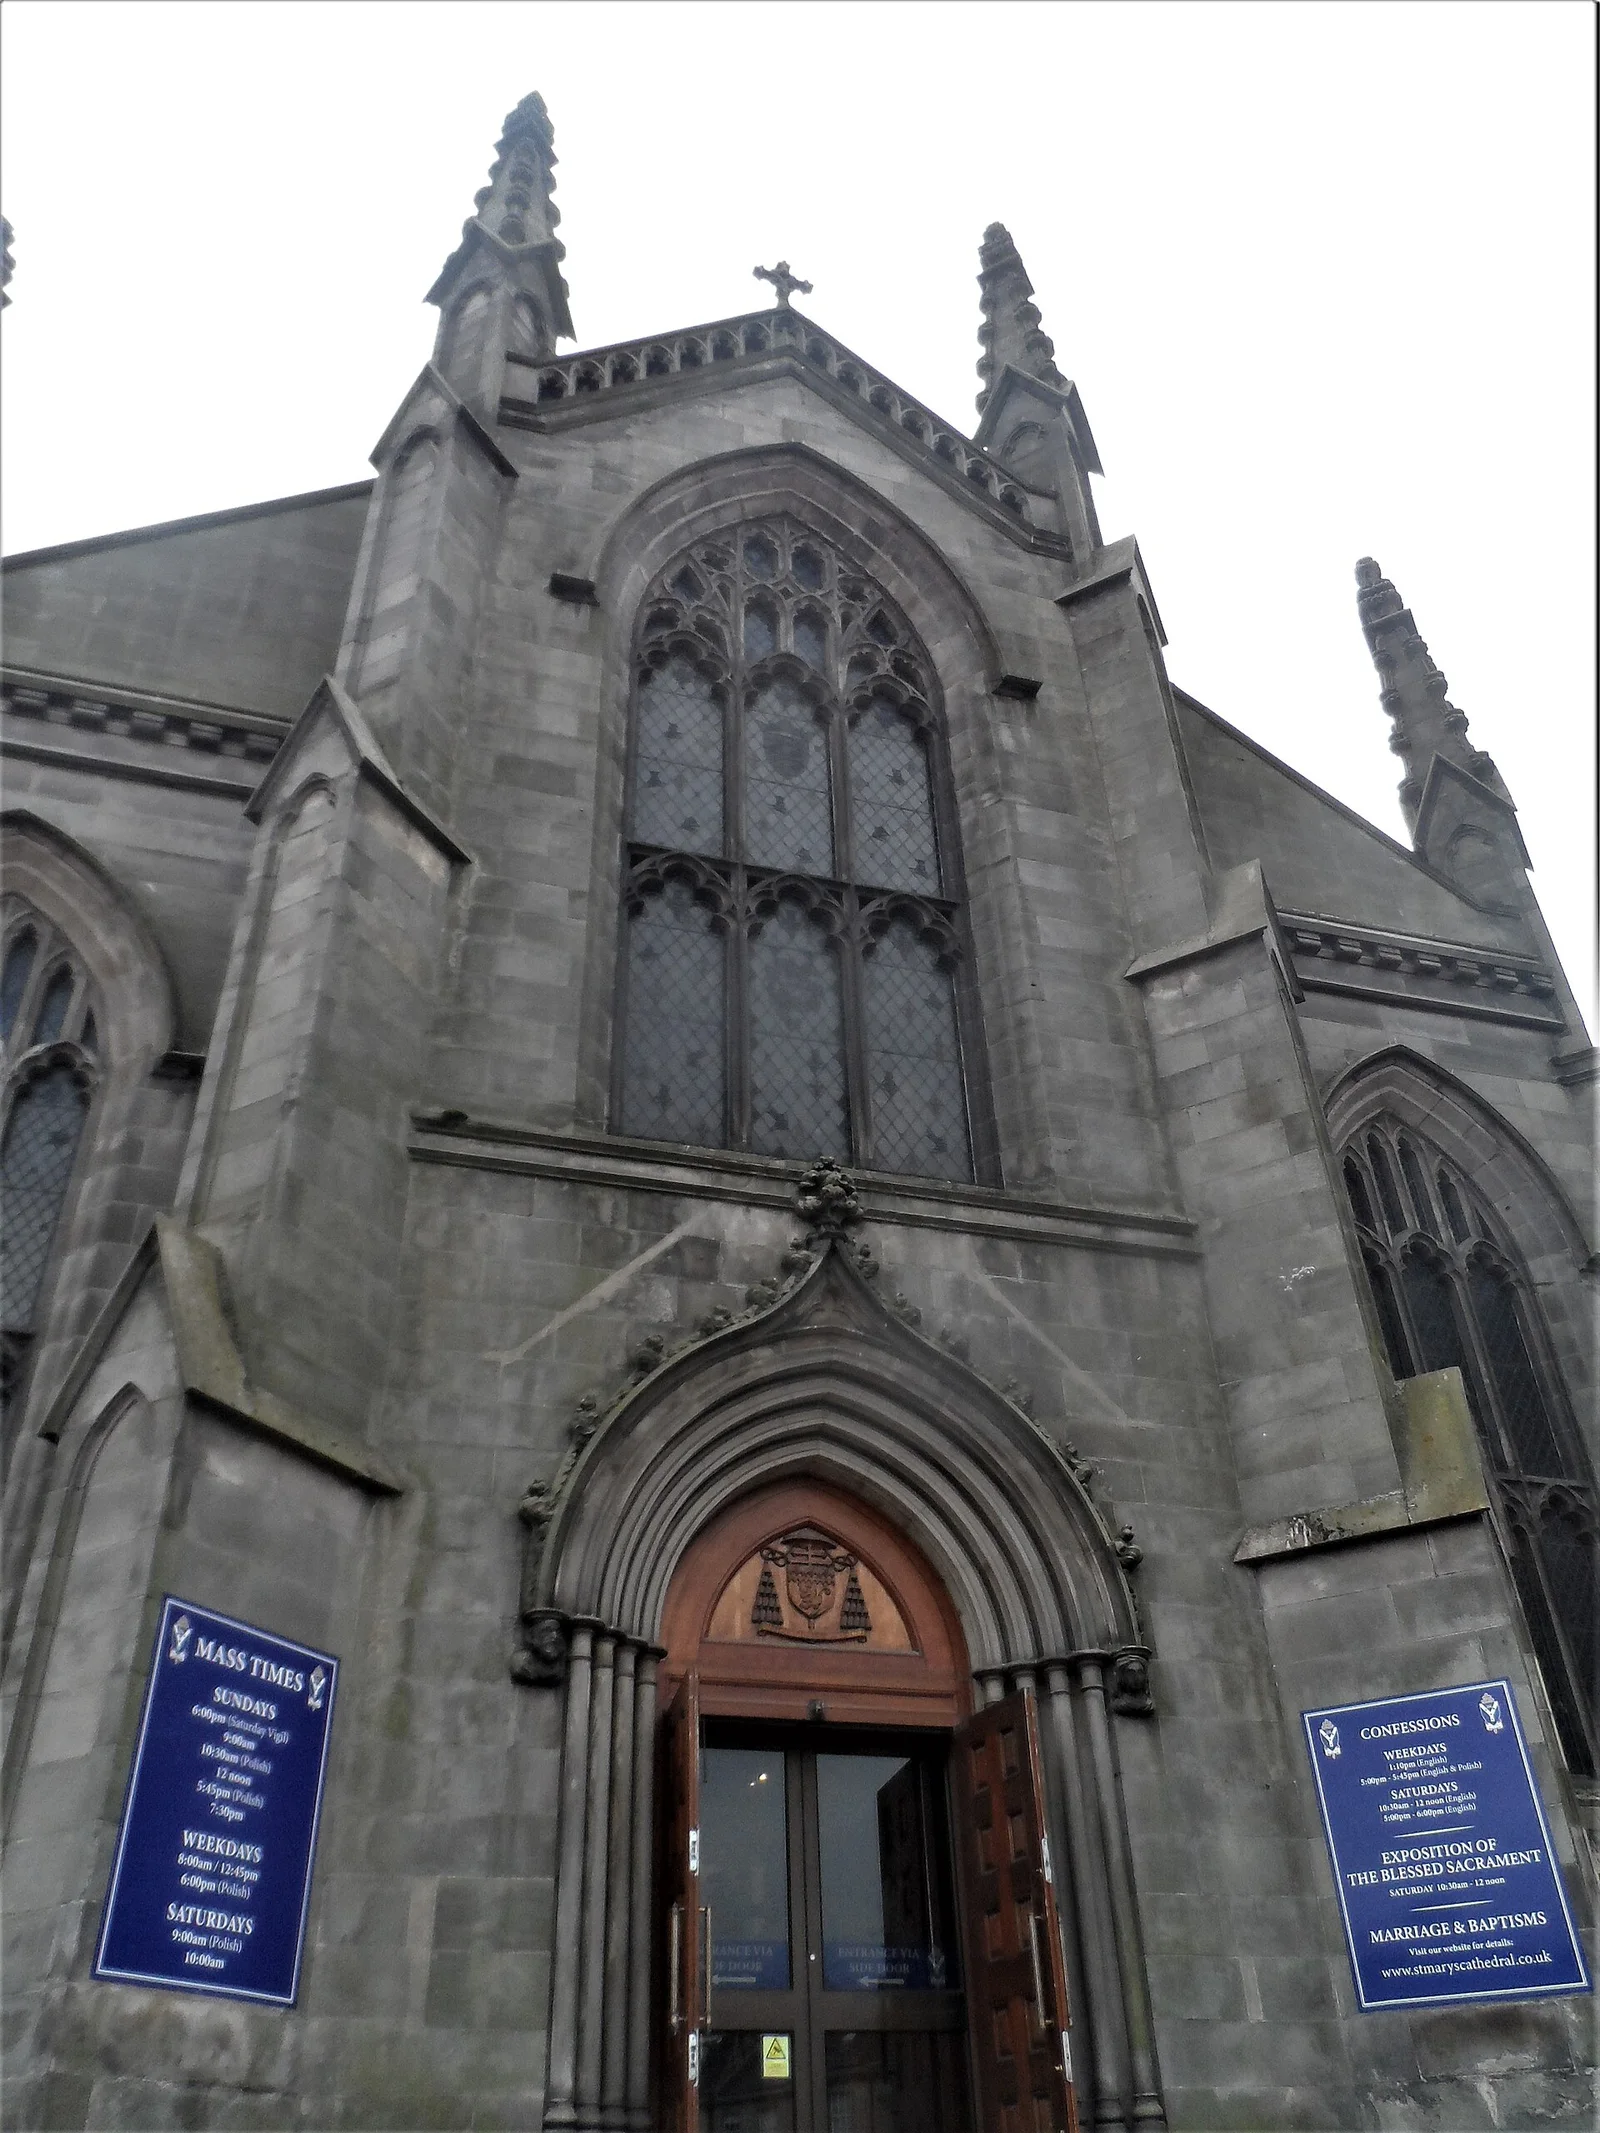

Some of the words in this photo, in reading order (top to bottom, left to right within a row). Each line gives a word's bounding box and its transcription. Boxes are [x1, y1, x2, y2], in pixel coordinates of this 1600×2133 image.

[194, 1637, 247, 1672] MASS
[250, 1653, 305, 1692] TIMES
[213, 1686, 277, 1720] SUNDAYS
[191, 1705, 226, 1724] 6:00pm
[228, 1714, 267, 1739] (Saturday
[267, 1727, 290, 1744] Vigil)
[1360, 1713, 1460, 1740] CONFESSIONS
[223, 1731, 255, 1750] 9:00am
[1383, 1742, 1447, 1761] WEEKDAYS
[200, 1743, 239, 1764] 10:30am
[240, 1755, 271, 1775] (Polish)
[1389, 1761, 1416, 1771] 1:10pm
[1416, 1755, 1448, 1768] (English)
[216, 1767, 227, 1780] 12
[228, 1770, 252, 1786] noon
[1360, 1775, 1387, 1786] 5:00pm
[1392, 1770, 1420, 1781] 5:45pm
[1420, 1766, 1449, 1778] (English
[1450, 1765, 1457, 1773] &
[1458, 1761, 1482, 1772] Polish)
[196, 1780, 231, 1799] 5:45pm
[232, 1789, 264, 1809] (Polish)
[1378, 1802, 1409, 1813] 10:30am
[1415, 1799, 1424, 1807] 12
[1425, 1797, 1445, 1806] noon
[1445, 1791, 1477, 1804] (English)
[1390, 1781, 1458, 1800] SATURDAYS
[210, 1802, 244, 1822] 7:30pm
[1383, 1811, 1411, 1822] 5:00pm
[1416, 1807, 1444, 1818] 6:00pm
[1445, 1802, 1477, 1815] (English)
[182, 1829, 262, 1863] WEEKDAYS
[1381, 1841, 1473, 1865] EXPOSITION
[1475, 1838, 1497, 1851] OF
[177, 1852, 213, 1871] 8:00am
[220, 1862, 258, 1882] 12:45pm
[1347, 1870, 1379, 1886] THE
[1380, 1862, 1444, 1882] BLESSED
[1446, 1849, 1541, 1874] SACRAMENT
[180, 1873, 216, 1893] 6:00pm
[217, 1880, 251, 1900] (Polish)
[1389, 1884, 1434, 1897] SATURDAY
[1437, 1880, 1468, 1892] 10:30am
[1475, 1878, 1484, 1887] 12
[1485, 1876, 1505, 1886] noon
[166, 1902, 254, 1935] SATURDAYS
[1369, 1922, 1451, 1944] MARRIAGE
[1454, 1920, 1466, 1934] &
[1467, 1911, 1547, 1933] BAPTISMS
[172, 1928, 207, 1947] 9:00am
[208, 1934, 243, 1953] (Polish)
[838, 1947, 898, 1959] ENTRANCE
[900, 1947, 920, 1960] VIA
[1408, 1947, 1427, 1957] Visit
[1428, 1947, 1441, 1955] our
[1443, 1942, 1471, 1953] website
[1471, 1941, 1483, 1950] for
[1485, 1938, 1514, 1949] details:
[184, 1951, 225, 1969] 10:00am
[1381, 1950, 1552, 1979] www.stmaryscathedral.co.uk
